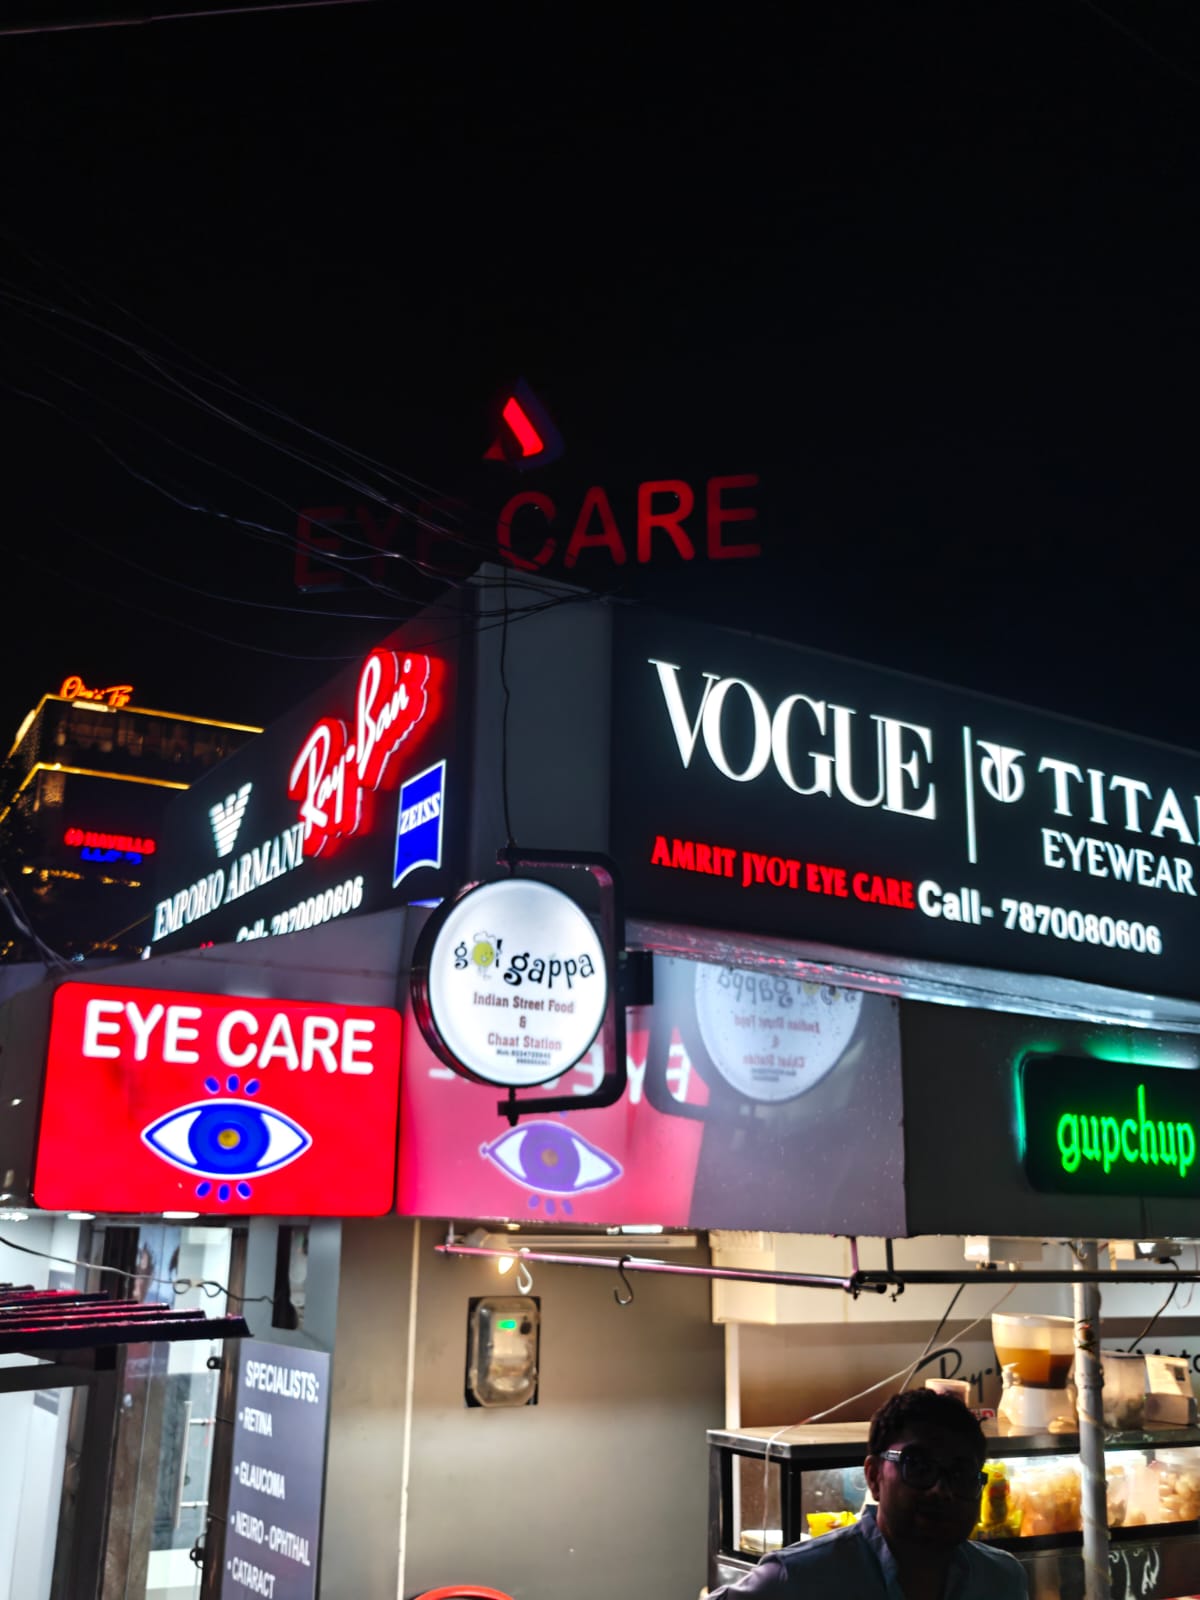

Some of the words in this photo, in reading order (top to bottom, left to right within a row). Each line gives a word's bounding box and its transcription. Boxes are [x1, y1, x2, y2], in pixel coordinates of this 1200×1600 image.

[294, 496, 468, 587] EYE
[497, 474, 762, 571] CARE
[289, 654, 411, 841] Ray-Ban
[647, 658, 937, 821] VOGUE
[400, 791, 441, 834] ZEISS
[1037, 756, 1200, 848] TITA
[152, 868, 225, 942] EMPORIO
[223, 821, 304, 905] ARMANI
[1041, 827, 1198, 897] EYEWEAR
[271, 875, 364, 936] 7870080606
[650, 835, 736, 880] AMRIT
[743, 852, 801, 889] JYOT
[806, 864, 848, 899] EYE
[853, 872, 916, 911] CARE
[917, 879, 995, 925] Call-
[1001, 898, 1163, 957] 7870080606
[503, 952, 596, 989] gappa
[473, 991, 510, 1008] Indian
[512, 996, 545, 1011] Street
[548, 999, 576, 1014] Food
[519, 1016, 527, 1029] &
[82, 998, 202, 1064] EYE
[216, 1009, 377, 1076] CARE
[487, 1032, 520, 1048] Chaat
[523, 1036, 563, 1051] Station
[1056, 1083, 1196, 1178] gupchup
[245, 1359, 320, 1404] SPECIALISTS:
[243, 1406, 273, 1438] RETINA
[239, 1461, 286, 1500] GLAUCOMA
[235, 1510, 265, 1545] NEURO
[268, 1524, 311, 1567] OPHTHAL
[231, 1556, 276, 1600] CATARACT
